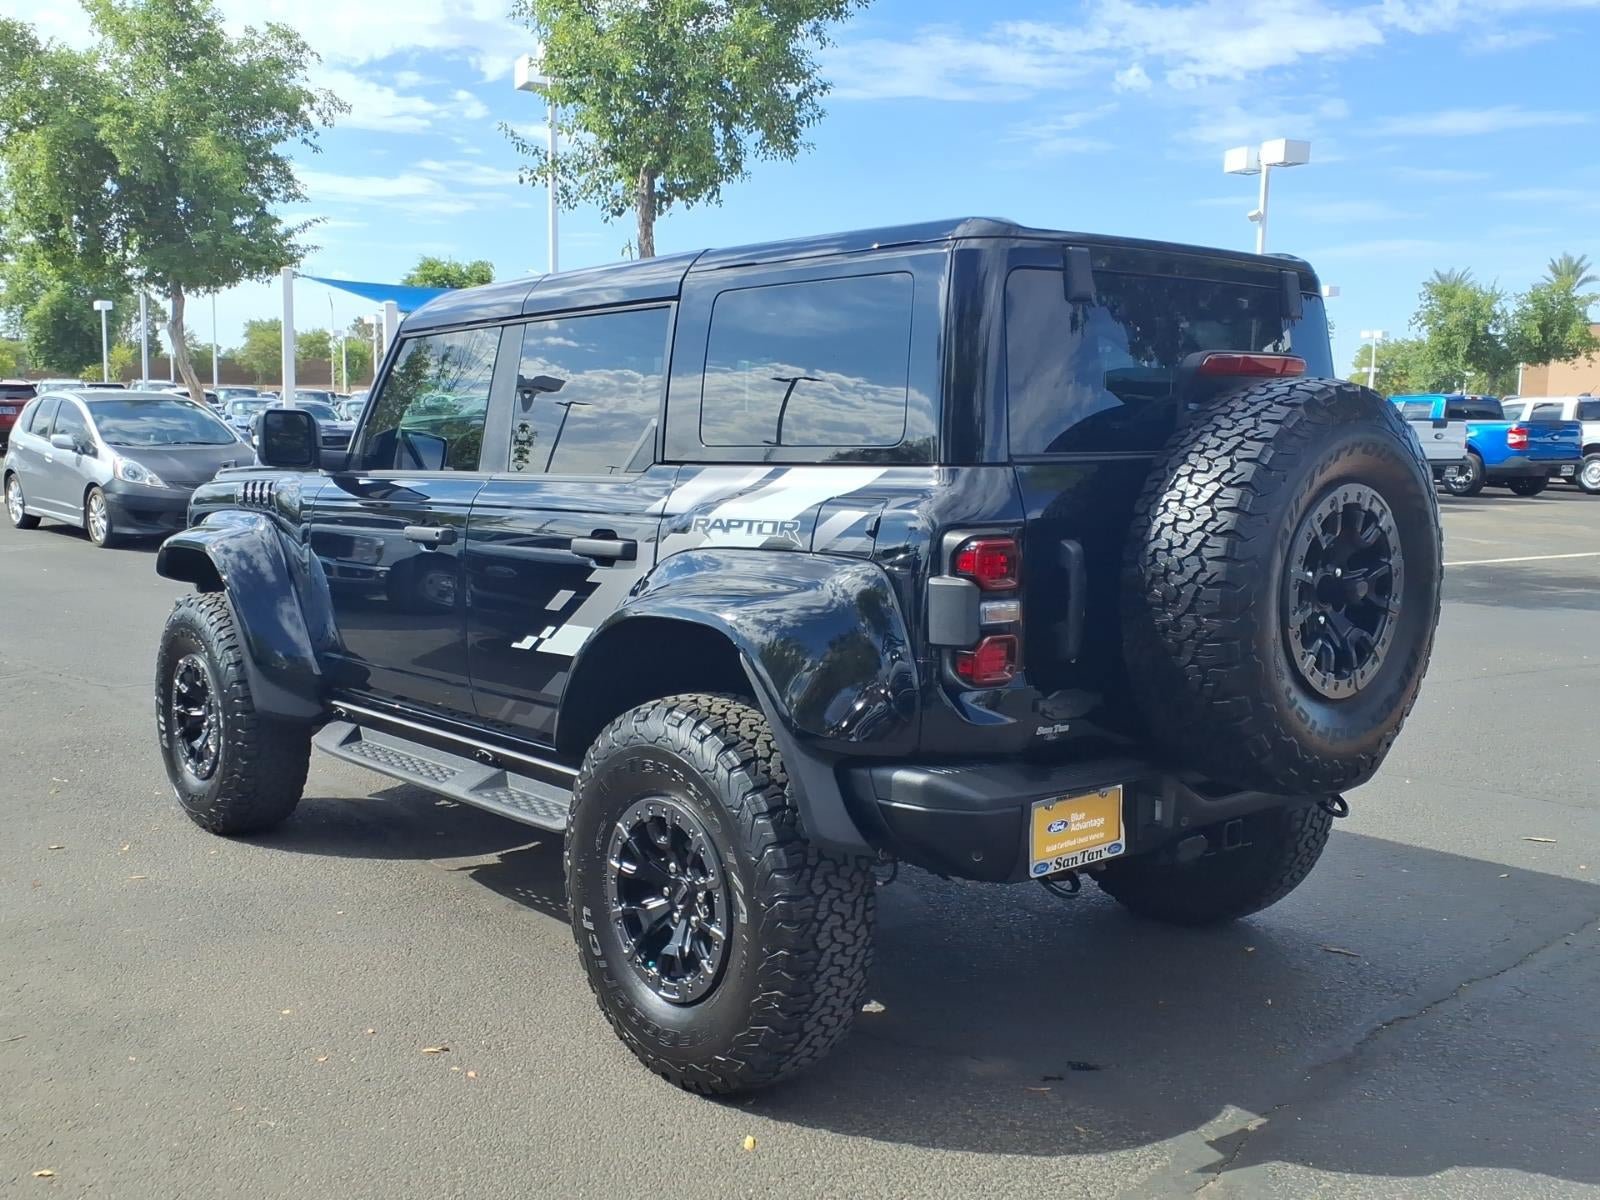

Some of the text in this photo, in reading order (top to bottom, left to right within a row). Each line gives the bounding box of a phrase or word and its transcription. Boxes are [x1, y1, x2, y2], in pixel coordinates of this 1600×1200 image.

[692, 517, 803, 547] RAPTOR
[1070, 812, 1086, 822] Blue
[1048, 820, 1069, 833] Ford
[1071, 817, 1105, 832] Advantage
[1057, 838, 1076, 850] Certified
[1053, 856, 1079, 871] San
[1080, 849, 1103, 863] Tan
